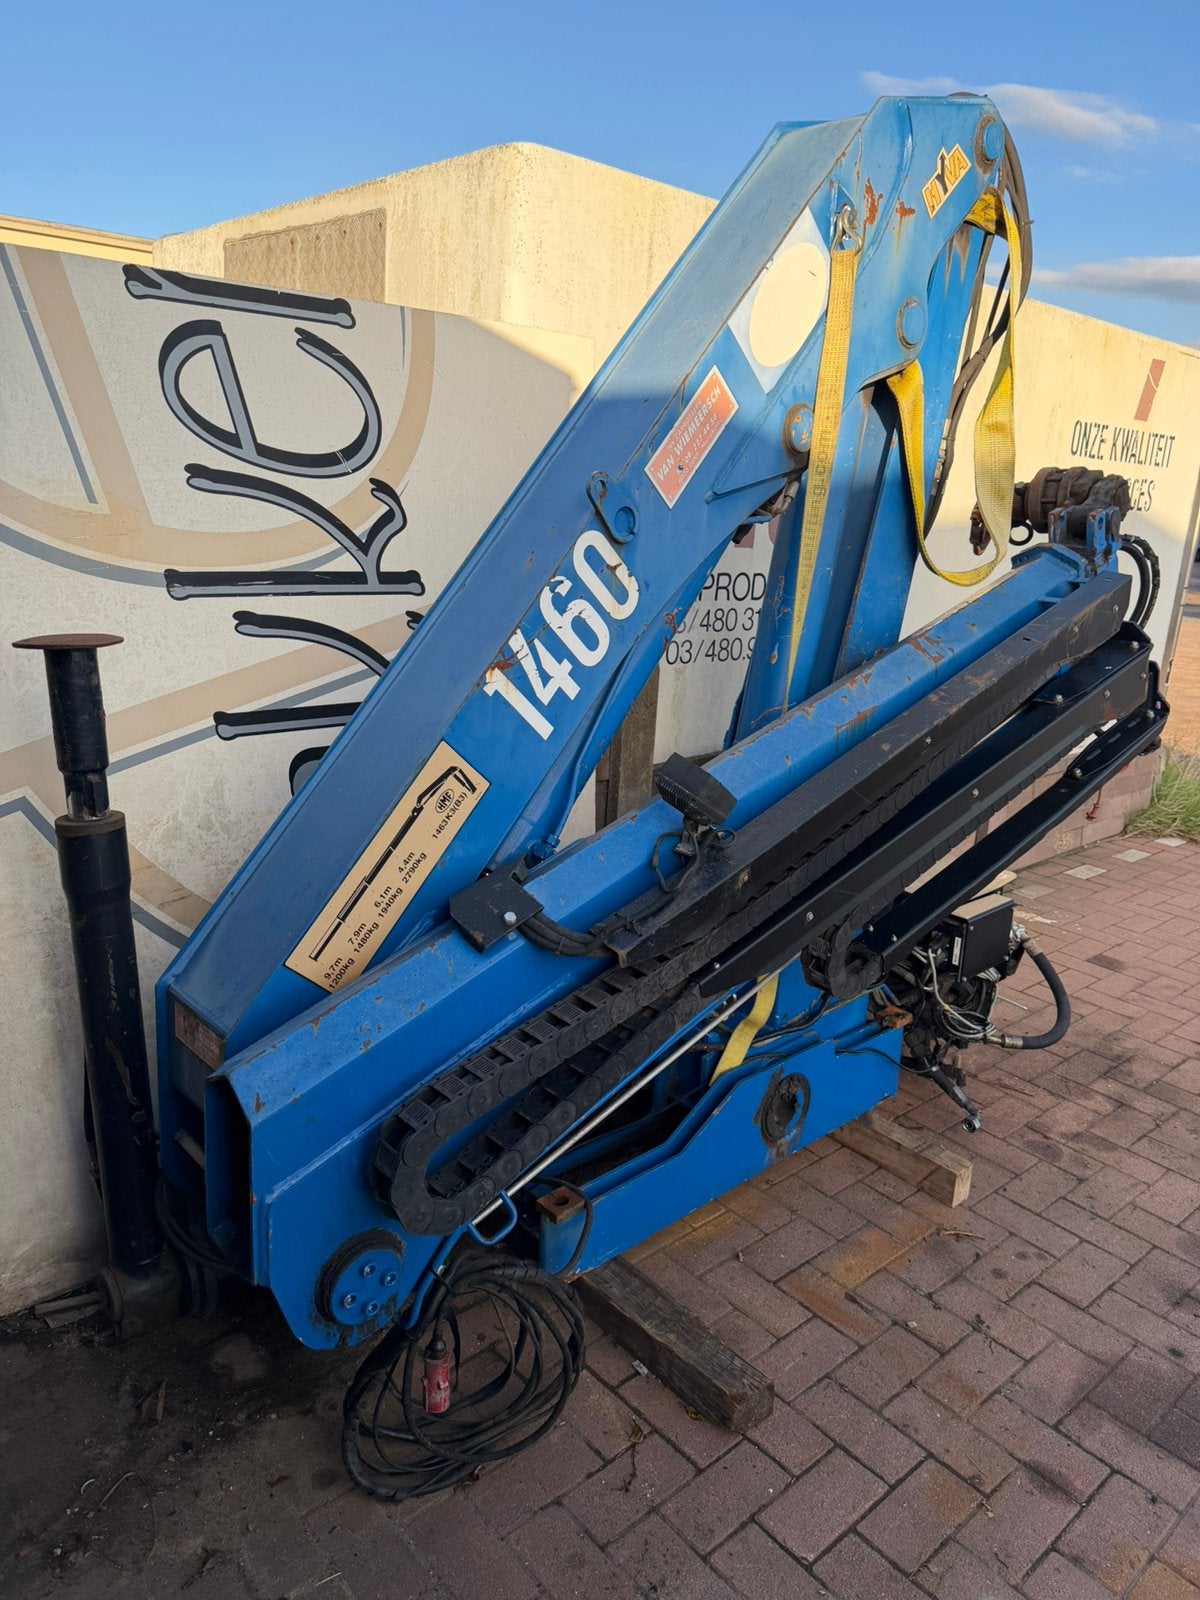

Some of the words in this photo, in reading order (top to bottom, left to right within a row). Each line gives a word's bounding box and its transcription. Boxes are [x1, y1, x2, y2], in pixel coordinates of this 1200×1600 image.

[924, 148, 969, 215] HYVA
[657, 455, 675, 481] VAN
[674, 384, 721, 457] WIEMEERSCH
[1070, 420, 1109, 460] ONZE
[1109, 426, 1176, 468] KWALITEIT
[1127, 478, 1156, 512] CES
[483, 529, 640, 741] 1460
[437, 790, 453, 812] HMF
[323, 957, 343, 981] 9,7m
[347, 922, 367, 945] 7,9m
[374, 886, 392, 909] 6,1m
[398, 852, 415, 874] 4,4m
[328, 958, 355, 990] 1200kg
[353, 922, 380, 954] 1480kg
[378, 887, 403, 918] 1940kg
[402, 852, 427, 884] 2790kg
